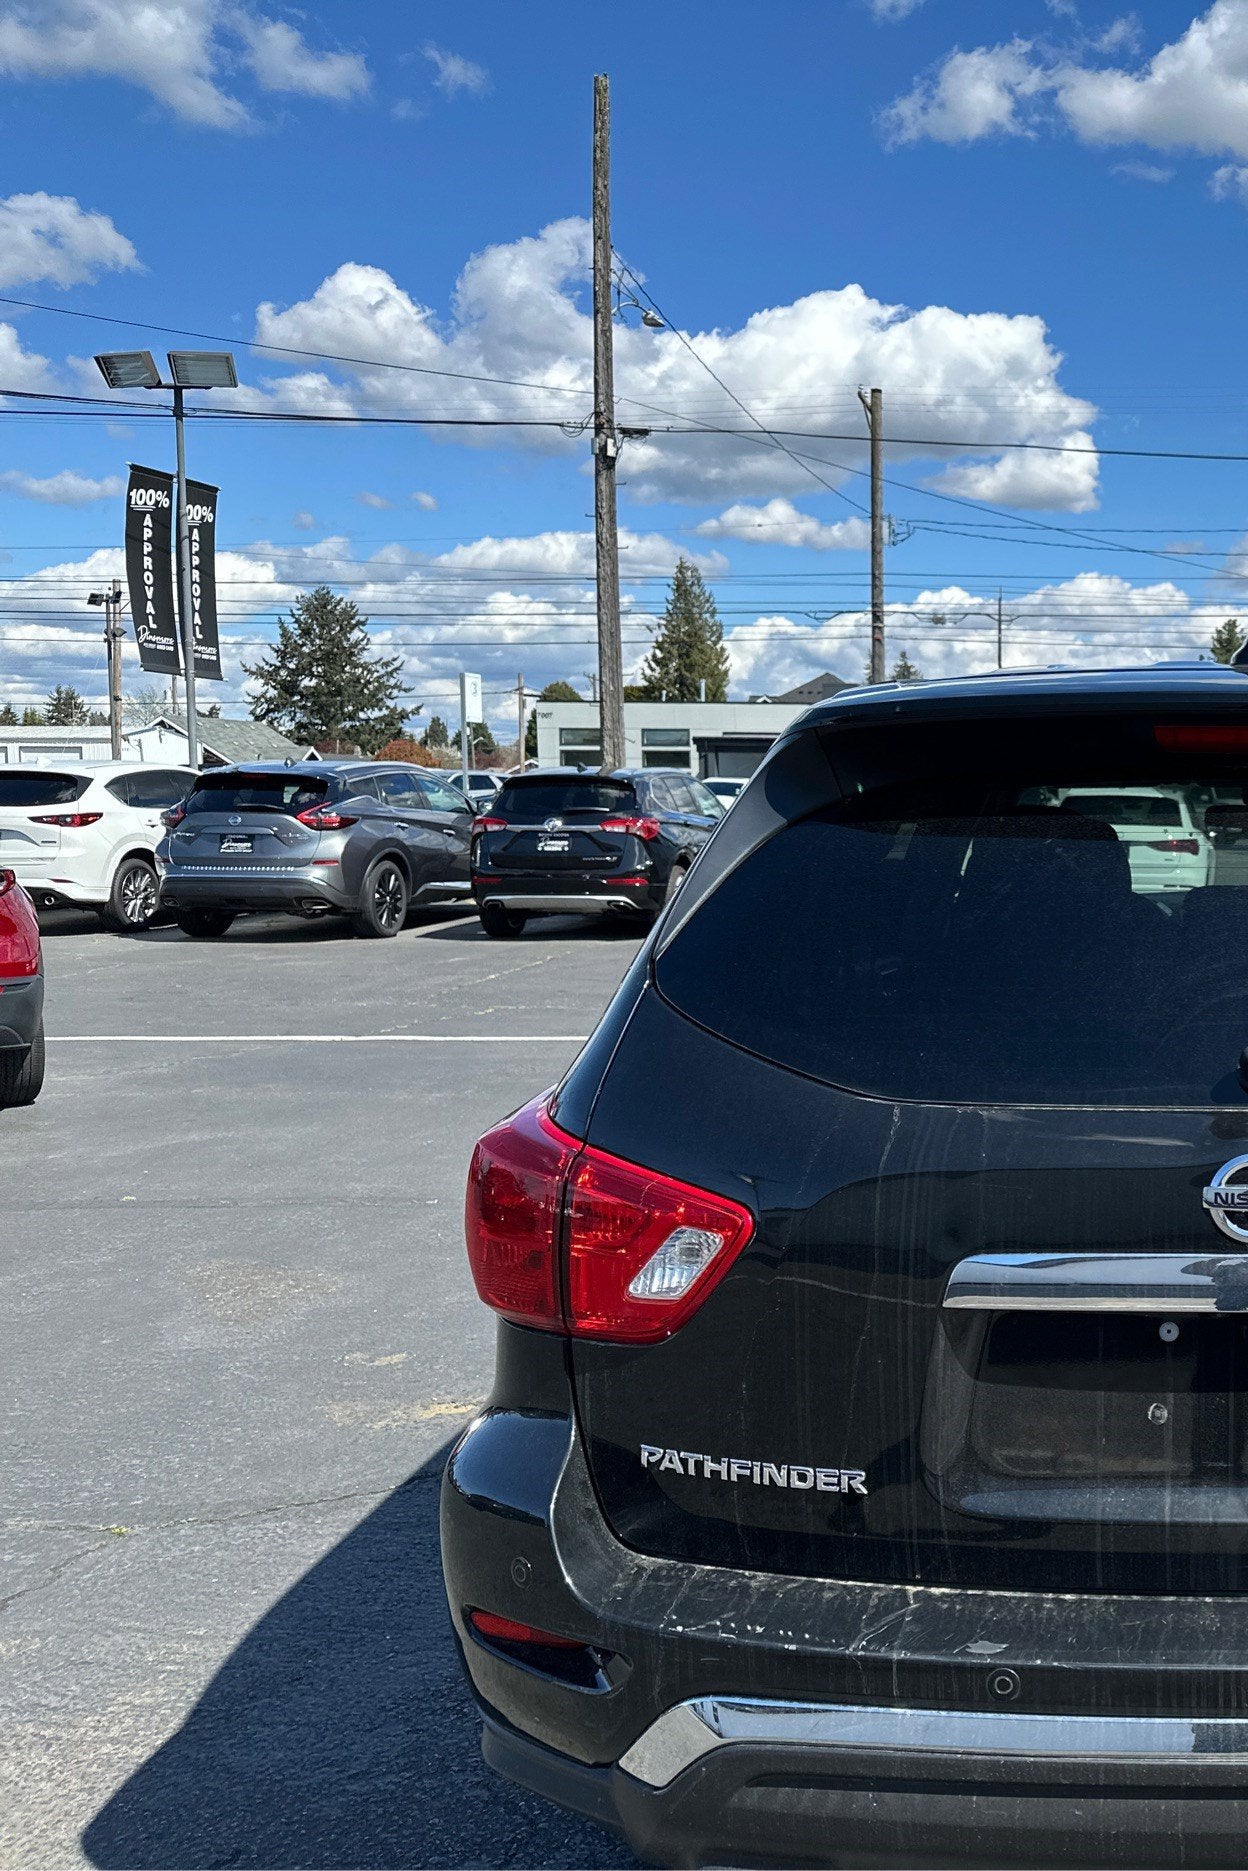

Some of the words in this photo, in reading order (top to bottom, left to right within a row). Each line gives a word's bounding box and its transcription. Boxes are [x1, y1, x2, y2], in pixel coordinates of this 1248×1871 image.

[129, 488, 170, 508] 100%
[186, 504, 214, 523] 00%
[143, 514, 157, 629] APPROVAL
[191, 528, 203, 639] APPROVAL
[640, 1444, 868, 1494] PATHFINDER
